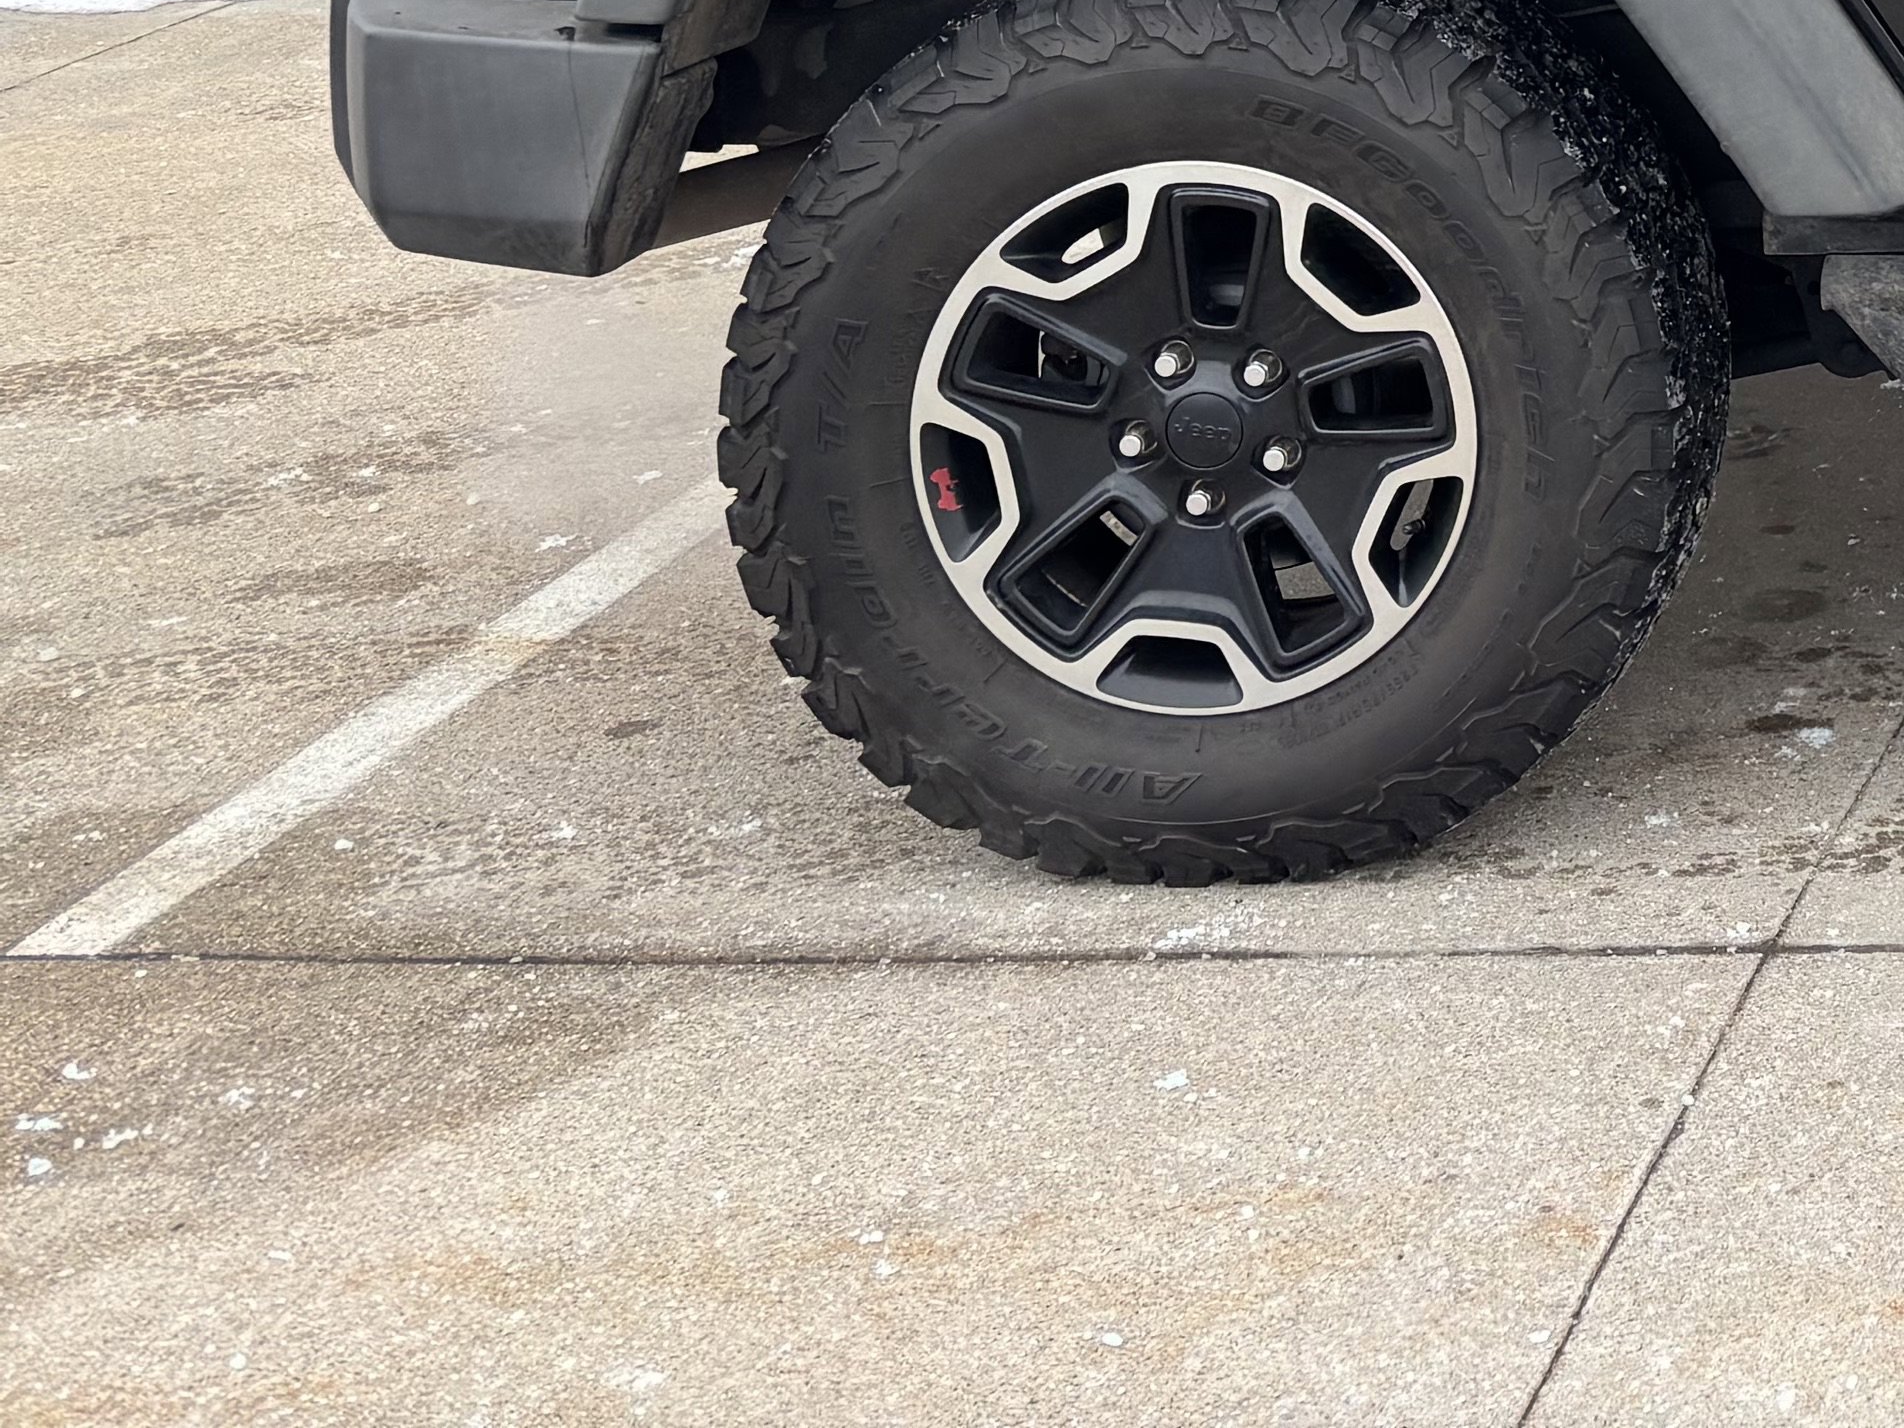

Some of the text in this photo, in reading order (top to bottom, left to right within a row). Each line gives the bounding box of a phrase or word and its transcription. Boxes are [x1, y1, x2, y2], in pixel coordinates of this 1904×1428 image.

[816, 317, 868, 454] T/A
[1247, 94, 1556, 503] BFGoodrich
[1173, 416, 1232, 442] Jeep
[824, 495, 1205, 806] All-Terrain
